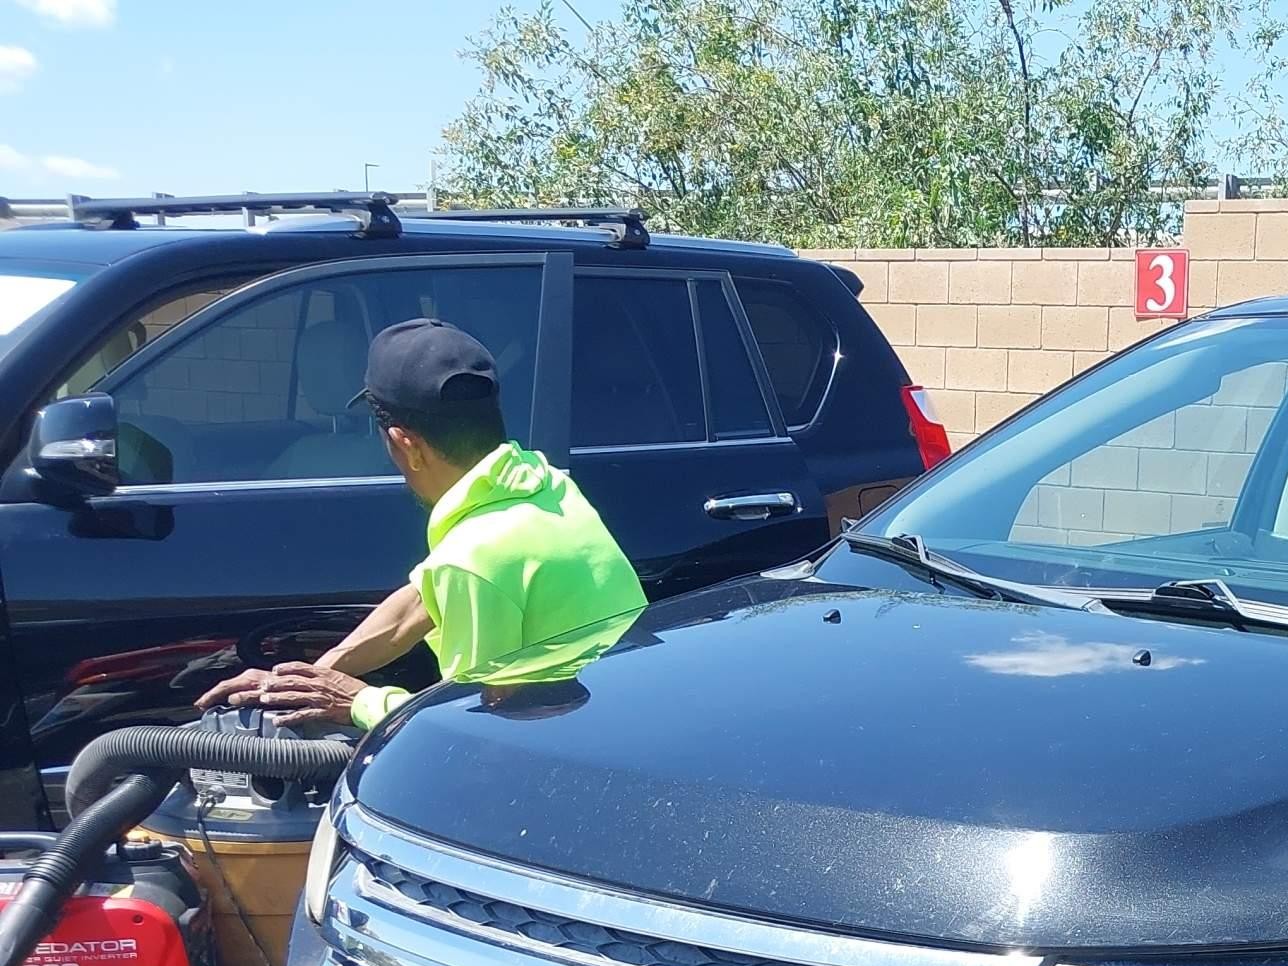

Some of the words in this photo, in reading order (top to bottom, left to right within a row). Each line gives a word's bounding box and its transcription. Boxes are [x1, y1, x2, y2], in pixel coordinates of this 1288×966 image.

[1145, 254, 1176, 312] 3
[35, 939, 137, 954] EDATOR
[80, 952, 138, 961] INVERTER
